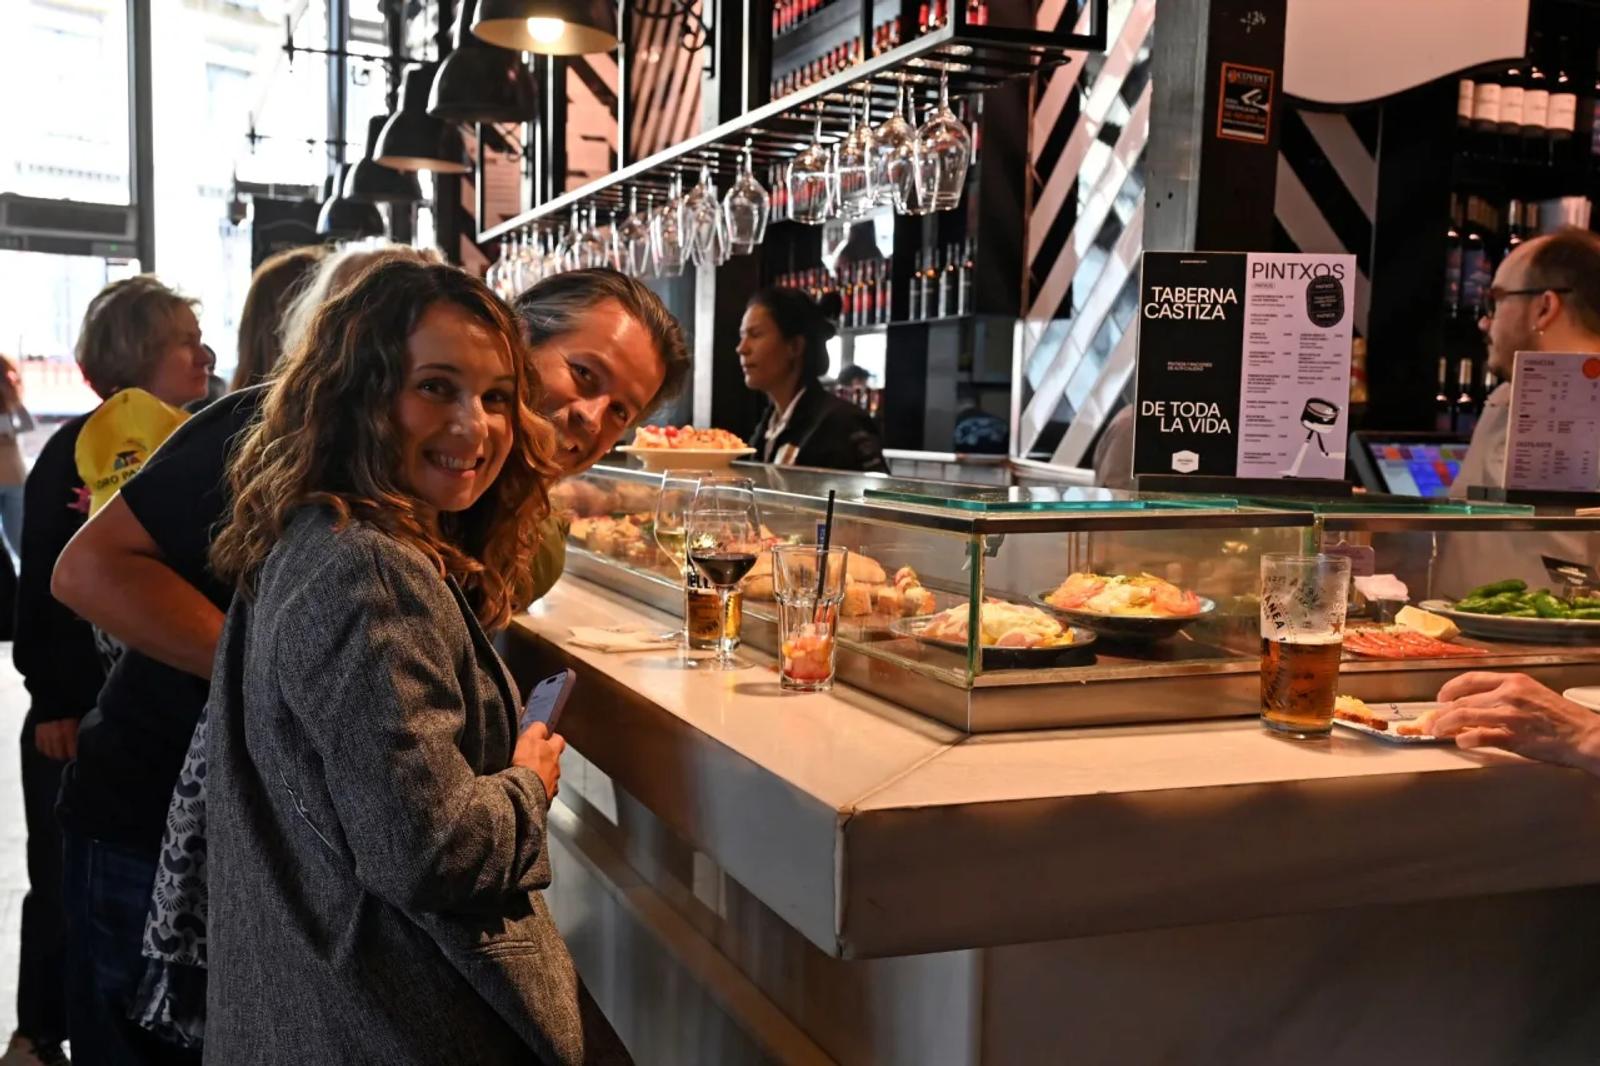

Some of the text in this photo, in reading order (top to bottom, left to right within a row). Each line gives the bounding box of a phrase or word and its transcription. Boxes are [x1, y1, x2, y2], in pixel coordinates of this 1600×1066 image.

[1252, 263, 1345, 281] PINTXOS
[1151, 286, 1238, 304] TABERNA
[1144, 303, 1226, 320] CASTIZA
[1142, 401, 1221, 418] DE TODA
[1160, 417, 1184, 433] LA
[1188, 418, 1232, 434] VIDA
